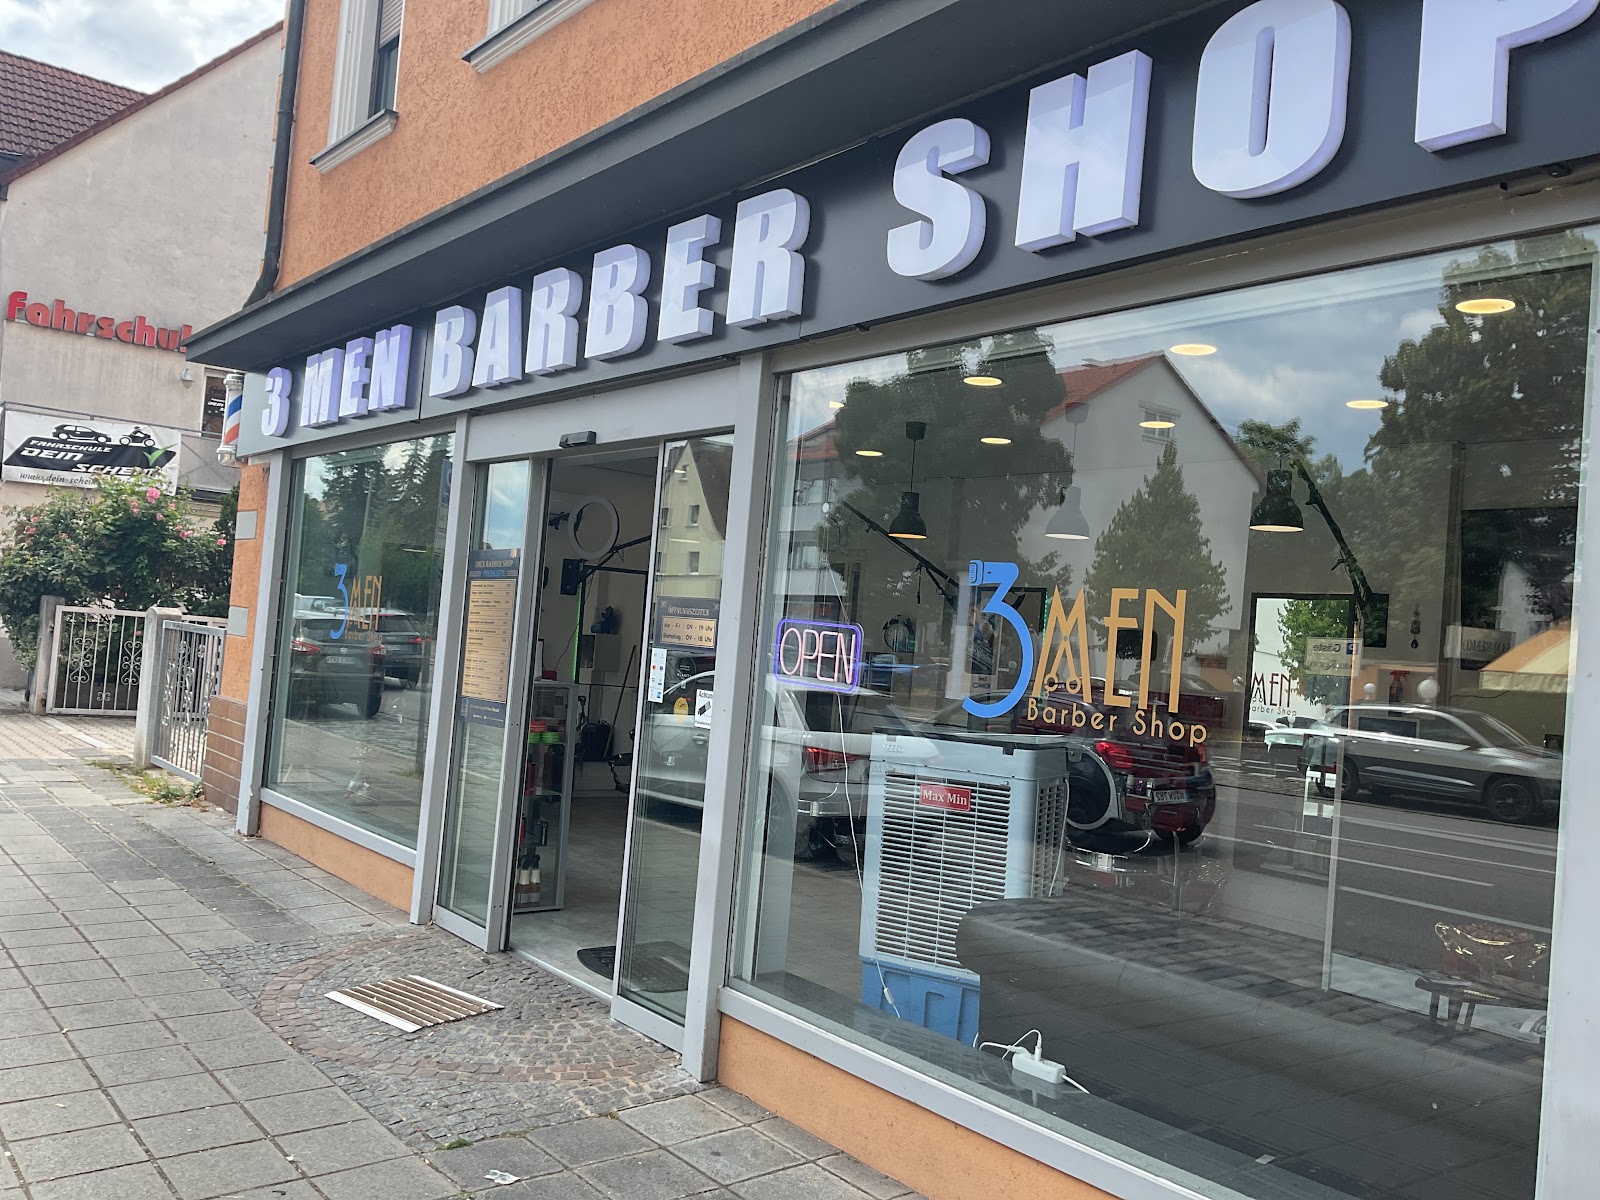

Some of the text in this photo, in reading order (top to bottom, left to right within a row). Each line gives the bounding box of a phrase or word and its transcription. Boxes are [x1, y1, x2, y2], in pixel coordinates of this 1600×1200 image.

[261, 0, 1599, 437] 3 MEN BARBER SHOP
[7, 291, 193, 353] Fahrschul
[21, 447, 84, 461] DEIN
[30, 440, 113, 453] FAHRSCHULE
[72, 463, 157, 478] SCHEN
[330, 562, 383, 640] 3 MEN
[780, 627, 857, 685] OPEN
[962, 559, 1187, 719] 3 MEN
[1250, 671, 1291, 708] MEN
[1251, 705, 1297, 717] arber Shop
[1027, 698, 1208, 748] Barber Shop
[923, 789, 968, 806] Max Min
